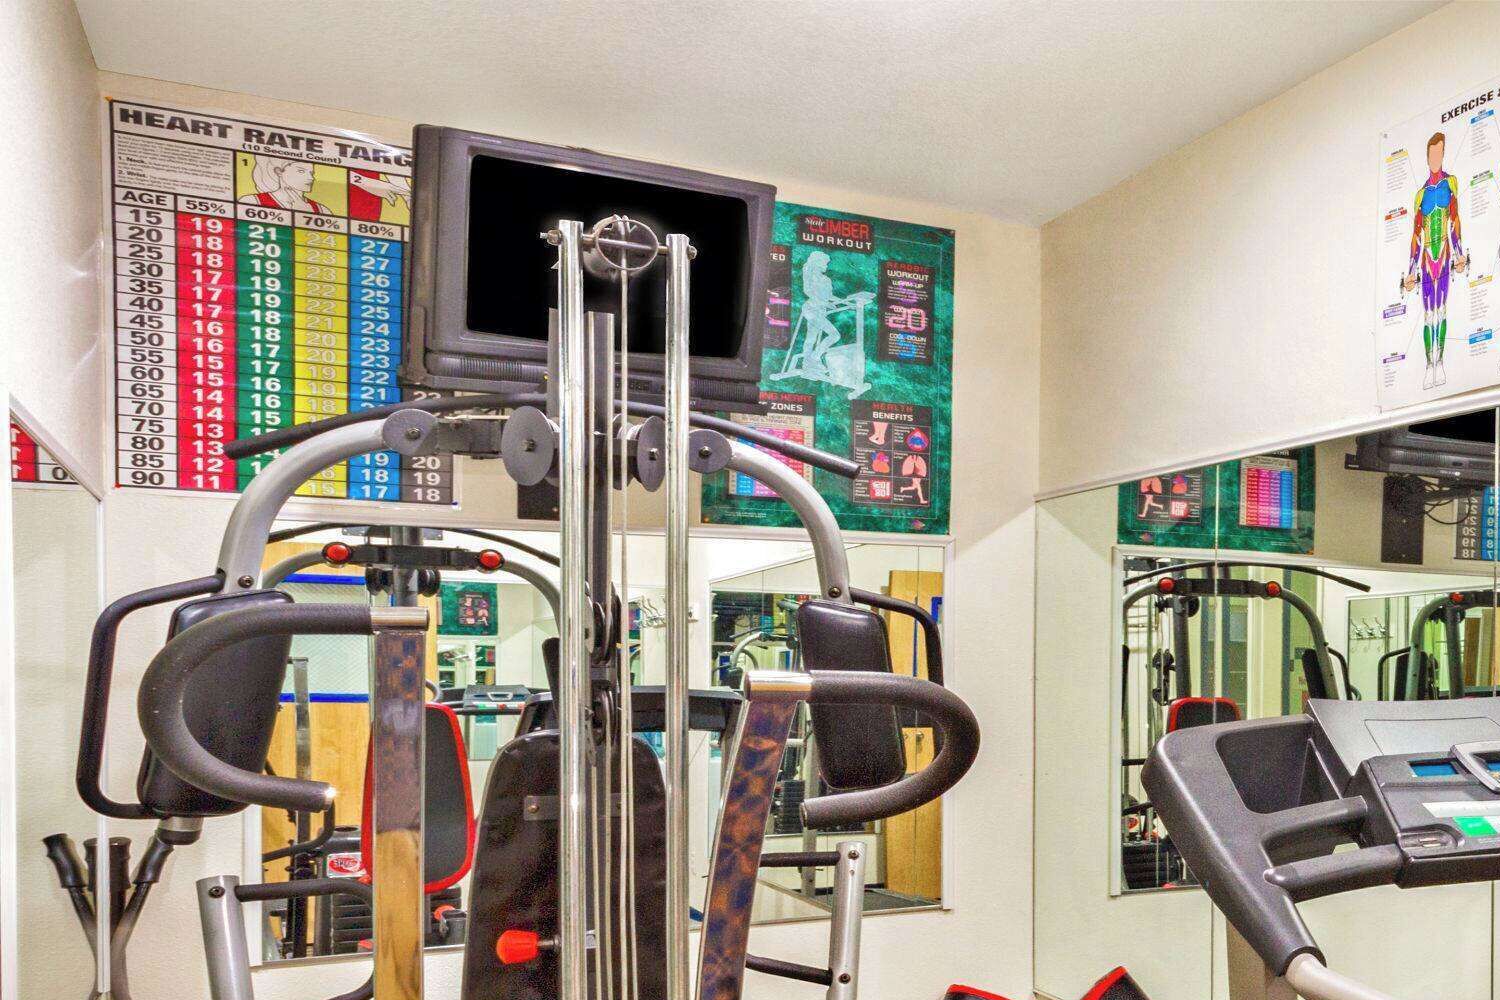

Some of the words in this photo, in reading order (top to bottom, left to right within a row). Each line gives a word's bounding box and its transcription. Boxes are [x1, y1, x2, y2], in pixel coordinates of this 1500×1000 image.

[1441, 90, 1494, 124] EXERCISE
[119, 107, 233, 139] HEART
[244, 127, 323, 154] RATE
[242, 159, 249, 167] 1
[263, 145, 303, 159] Second
[306, 152, 342, 165] Count)
[353, 175, 362, 184] 2
[122, 190, 168, 207] AGE
[186, 200, 226, 215] 55%
[245, 208, 284, 222] 60%
[302, 216, 340, 230] 70%
[358, 223, 394, 237] 80%
[128, 209, 163, 225] 15
[191, 218, 223, 234] 19
[248, 225, 278, 241] 21
[307, 233, 336, 248] 24
[361, 240, 390, 255] 27
[129, 226, 163, 243] 20
[191, 235, 223, 251] 18
[248, 242, 279, 258] 20
[307, 249, 336, 265] 23
[361, 256, 390, 271] 27
[802, 232, 871, 251] WORKOUT
[129, 244, 163, 260] 25
[191, 252, 223, 268] 18
[248, 258, 279, 275] 19
[307, 266, 336, 281] 23
[361, 272, 390, 288] 26
[129, 261, 163, 278] 30
[191, 269, 223, 285] 17
[249, 275, 279, 292] 19
[307, 282, 336, 298] 22
[361, 289, 390, 304] 25
[887, 269, 930, 282] WORKOUT
[129, 279, 163, 295] 35
[191, 286, 223, 302] 17
[249, 292, 279, 308] 19
[307, 299, 336, 314] 22
[361, 305, 390, 320] 25
[129, 296, 163, 312] 40
[192, 303, 223, 319] 17
[249, 309, 279, 325] 18
[307, 315, 336, 331] 21
[361, 321, 389, 336] 24
[129, 314, 163, 330] 45
[192, 320, 223, 336] 16
[249, 326, 279, 342] 18
[307, 332, 336, 348] 20
[361, 338, 389, 353] 23
[129, 331, 163, 347] 50
[192, 338, 223, 353] 16
[250, 343, 280, 359] 17
[308, 349, 336, 364] 20
[361, 354, 389, 369] 23
[130, 349, 163, 365] 55
[192, 355, 223, 370] 15
[250, 359, 280, 376] 17
[308, 365, 336, 381] 19
[361, 370, 389, 385] 22
[130, 366, 164, 382] 60
[192, 372, 223, 387] 15
[250, 376, 280, 393] 16
[308, 382, 336, 397] 19
[361, 387, 389, 402] 21
[130, 384, 164, 399] 65
[192, 389, 223, 404] 14
[250, 393, 280, 409] 16
[308, 398, 336, 414] 18
[130, 401, 164, 417] 70
[192, 406, 223, 421] 14
[251, 410, 280, 426] 15
[771, 402, 803, 412] ZONES
[130, 419, 164, 434] 75
[192, 423, 223, 438] 13
[872, 411, 914, 422] BENEFITS
[130, 436, 164, 452] 80
[193, 440, 223, 455] 13
[362, 453, 389, 466] 19
[413, 456, 441, 470] 20
[130, 454, 164, 469] 85
[193, 457, 223, 472] 12
[361, 468, 389, 483] 18
[413, 472, 441, 486] 19
[131, 471, 164, 486] 90
[193, 474, 220, 489] 11
[361, 484, 388, 499] 17
[413, 487, 441, 502] 18
